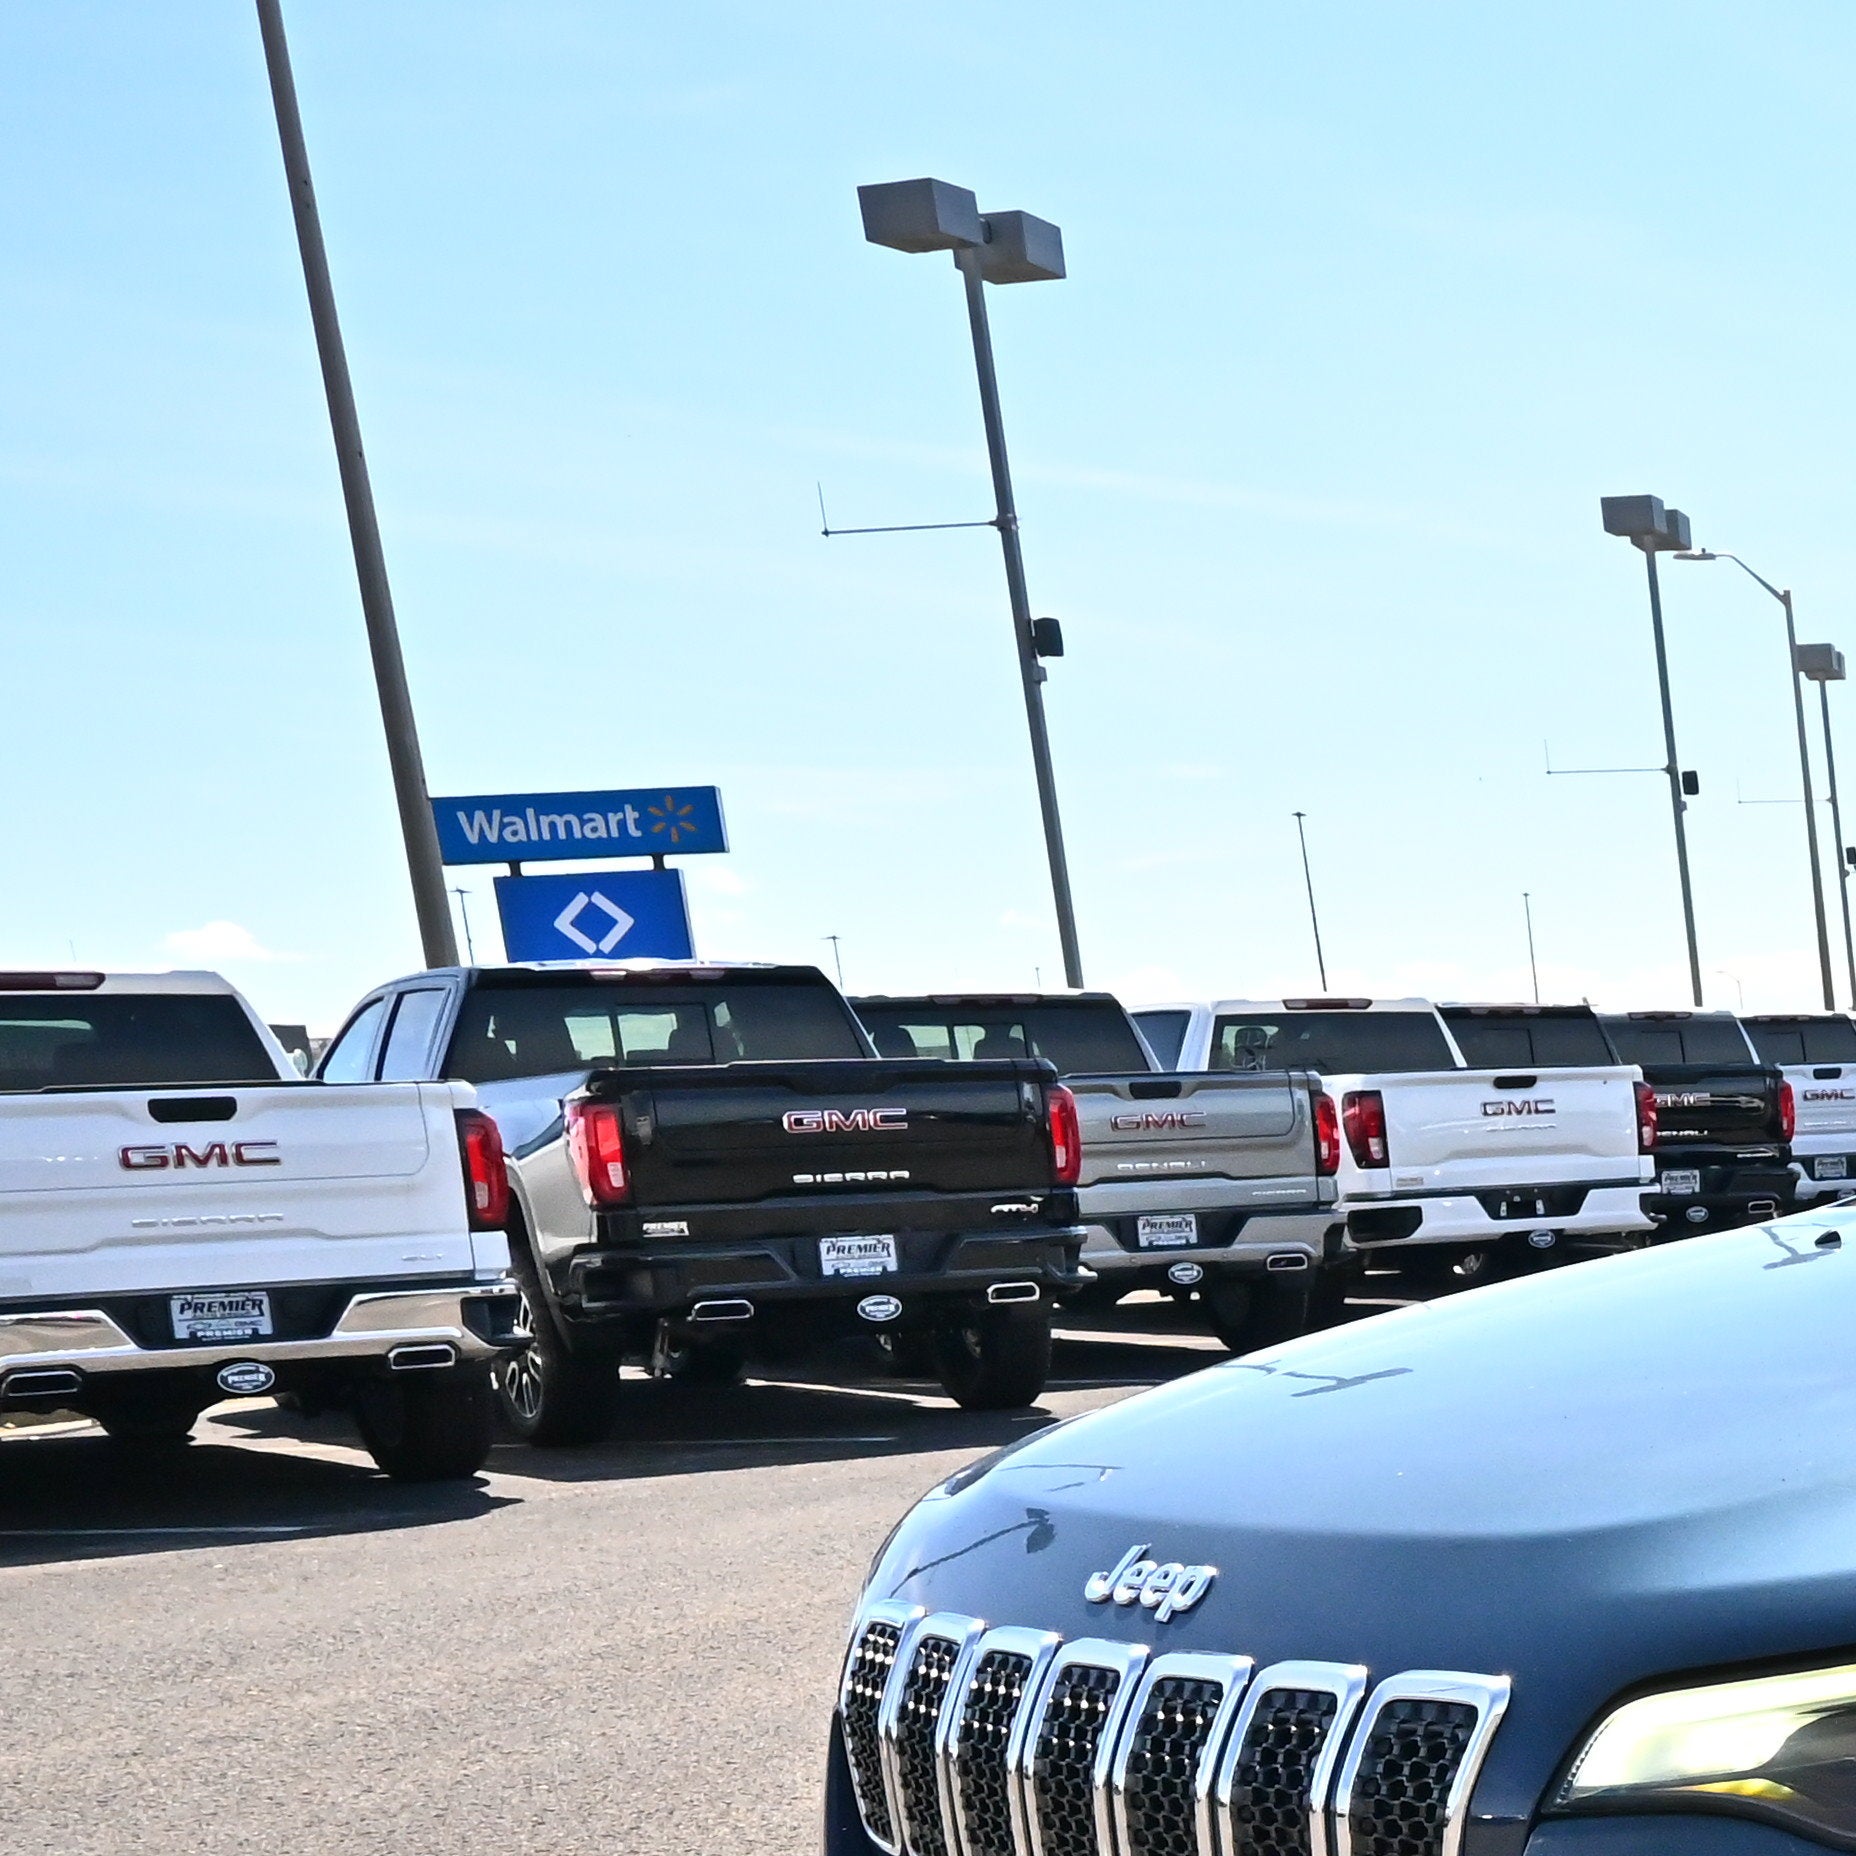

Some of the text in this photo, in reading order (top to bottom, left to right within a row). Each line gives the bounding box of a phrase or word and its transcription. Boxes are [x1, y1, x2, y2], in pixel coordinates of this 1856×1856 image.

[457, 804, 642, 844] Walmart
[1803, 1089, 1855, 1101] GMC
[1481, 1099, 1556, 1116] GMC
[782, 1108, 908, 1133] GMC
[1110, 1111, 1207, 1131] GMC
[119, 1140, 281, 1171] GMC
[826, 1240, 892, 1258] PREMIER
[179, 1297, 265, 1316] PREMIER
[1085, 1543, 1218, 1622] Jeep
